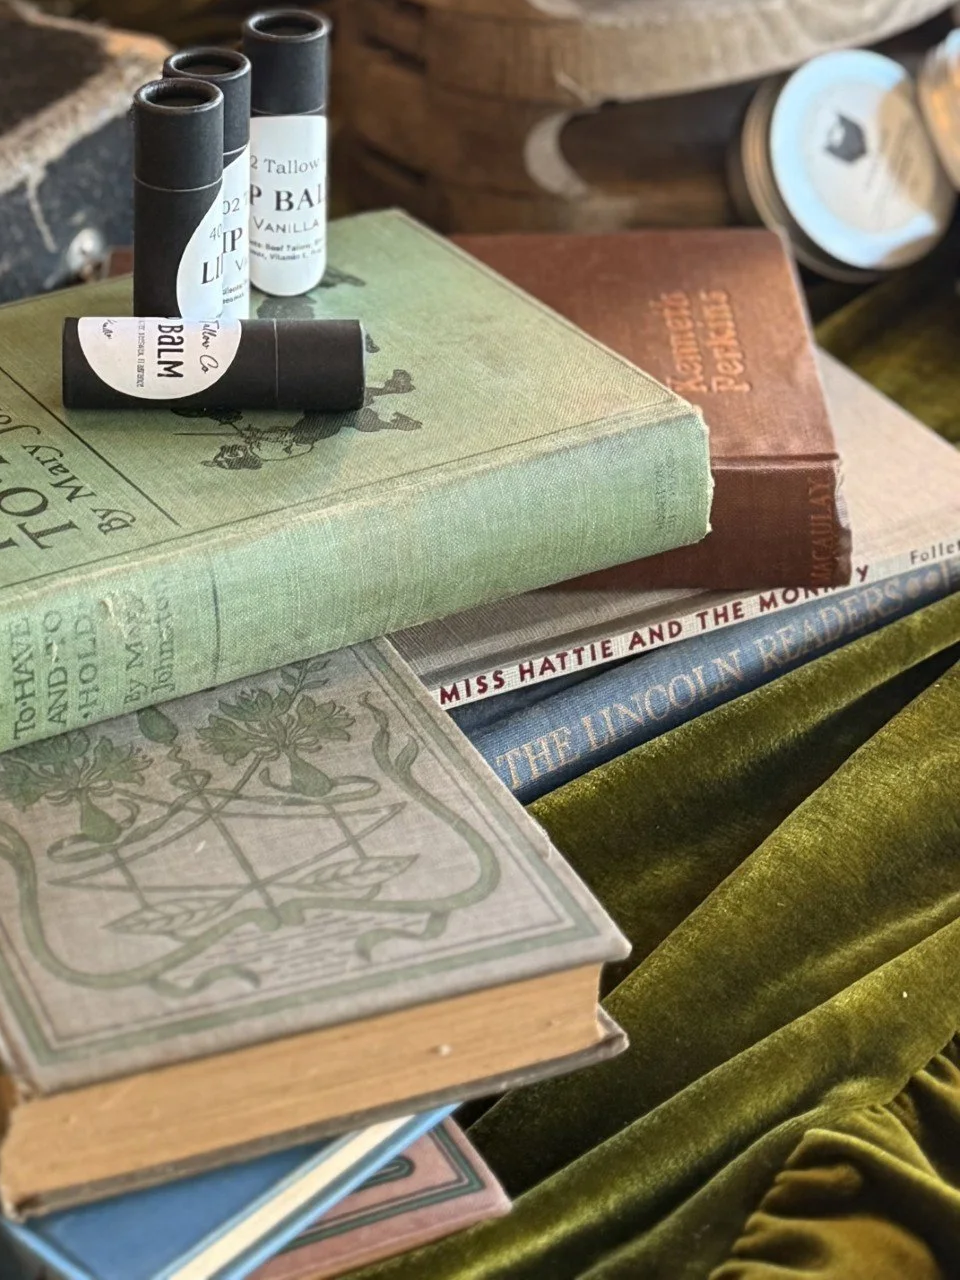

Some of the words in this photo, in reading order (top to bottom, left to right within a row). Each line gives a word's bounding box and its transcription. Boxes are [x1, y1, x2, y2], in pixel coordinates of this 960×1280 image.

[264, 158, 320, 174] Tallow
[253, 215, 319, 234] VANILLA
[199, 354, 219, 373] Co
[700, 288, 752, 394] Perkins
[21, 443, 97, 503] Mary
[91, 506, 136, 535] By
[808, 479, 835, 582] MACAULAY
[440, 670, 505, 705] MISS
[519, 639, 614, 682] HATTIE
[628, 620, 682, 650] AND
[696, 600, 744, 630] THE
[759, 565, 869, 612] MONY
[47, 666, 68, 726] AND
[124, 678, 148, 705] By
[496, 726, 580, 790] THE
[581, 650, 745, 750] LINCOLN
[753, 578, 903, 672] READERS
